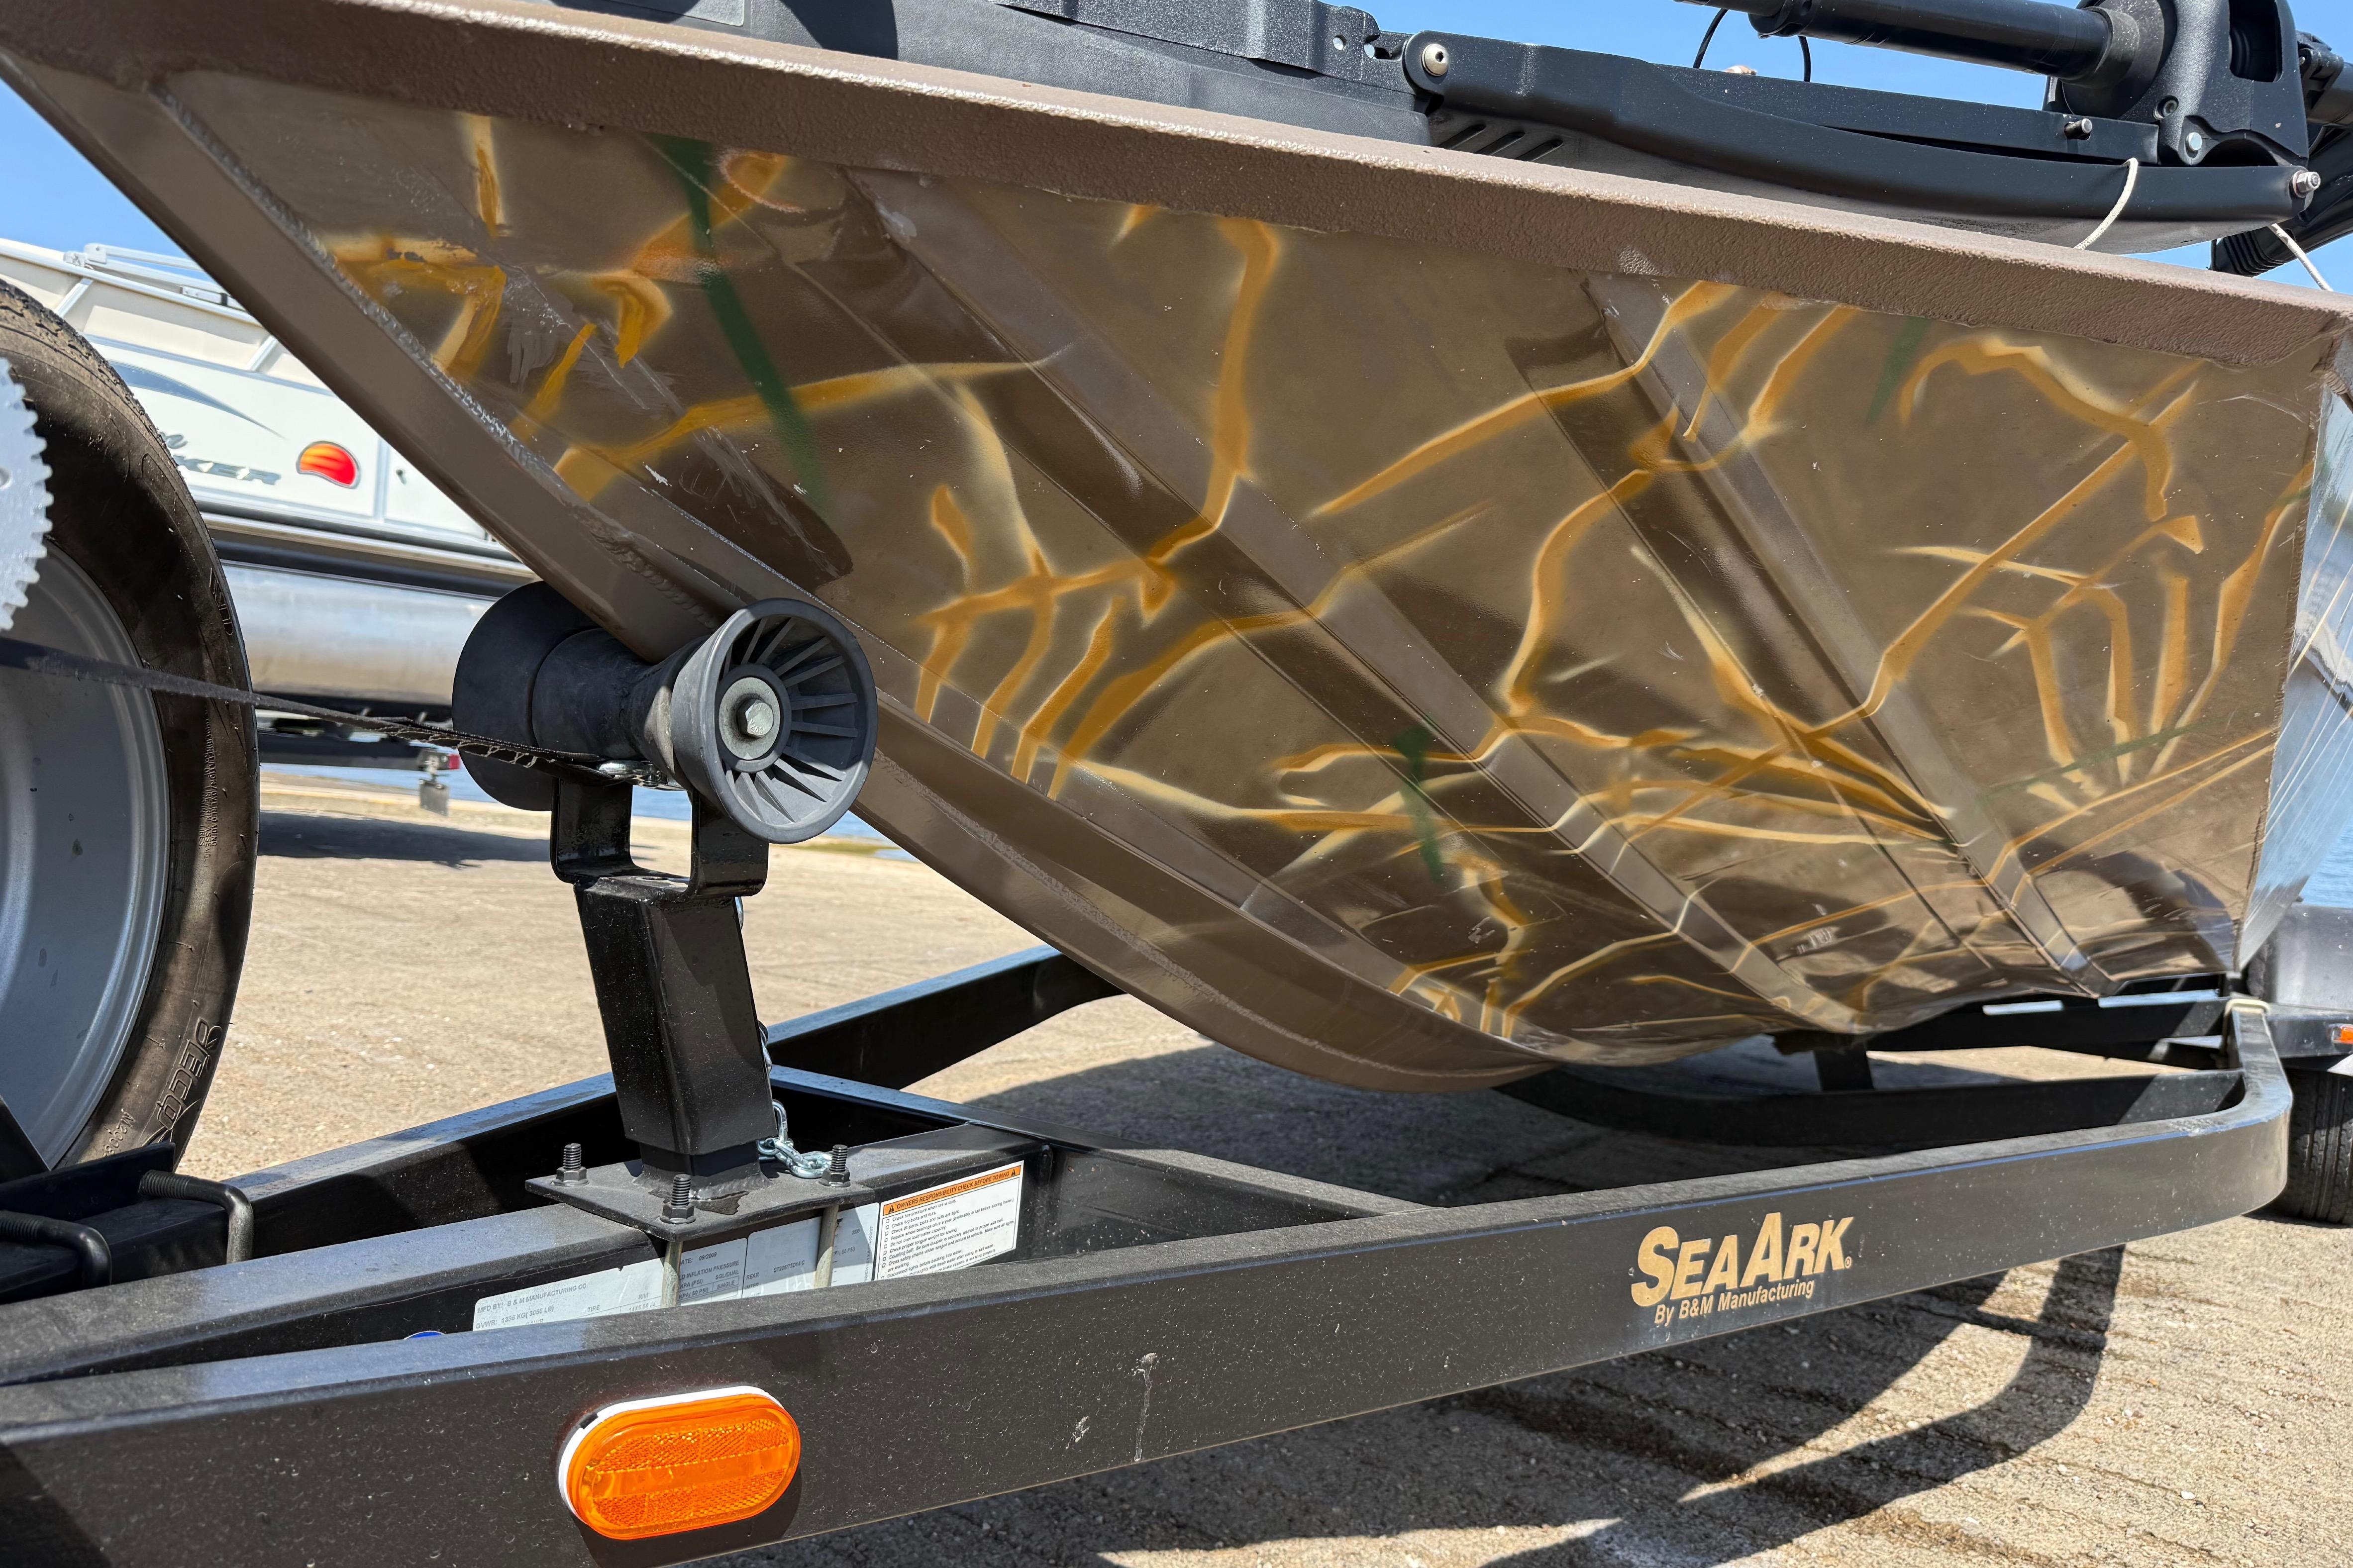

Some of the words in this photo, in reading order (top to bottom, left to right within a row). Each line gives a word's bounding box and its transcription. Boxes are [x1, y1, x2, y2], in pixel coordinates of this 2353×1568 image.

[896, 1197, 919, 1209] OWNERS
[919, 1186, 957, 1202] RESPONSIBILITY
[957, 1181, 973, 1191] CHECK
[975, 1176, 991, 1186] BEFORE
[993, 1171, 1009, 1180] TOWING
[687, 1268, 712, 1278] INFLATION
[714, 1261, 739, 1272] PRESSURE
[526, 1285, 577, 1302] MANUFACTURING
[1654, 1303, 1674, 1327] By
[1679, 1295, 1713, 1319] B&M
[1717, 1278, 1815, 1312] Manufacturing
